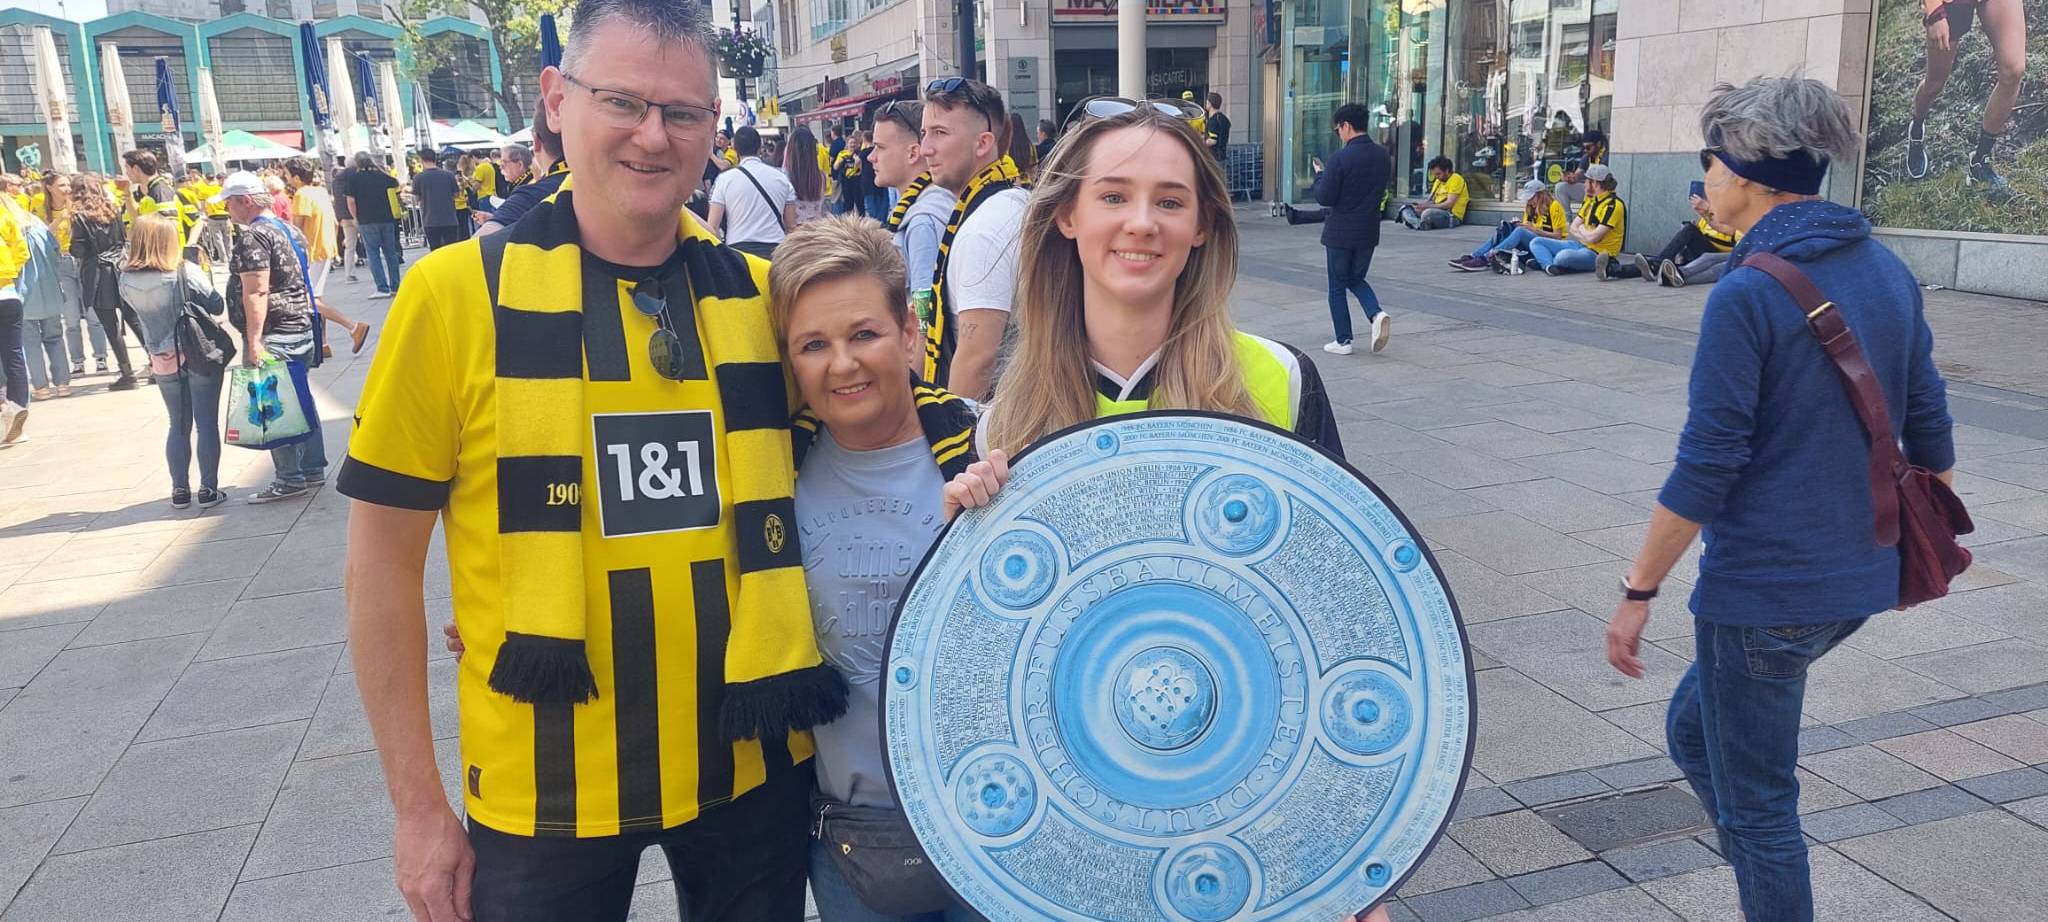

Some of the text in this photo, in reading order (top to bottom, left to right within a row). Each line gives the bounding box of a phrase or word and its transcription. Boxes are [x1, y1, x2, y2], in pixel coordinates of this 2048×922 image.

[607, 440, 704, 501] 1&1
[546, 483, 582, 505] 190
[838, 536, 912, 579] time
[870, 580, 889, 598] TO
[1436, 596, 1453, 630] WERDER
[1028, 559, 1305, 773] FUSSBALLMEISTER
[1028, 697, 1263, 832] DEUTSCHER
